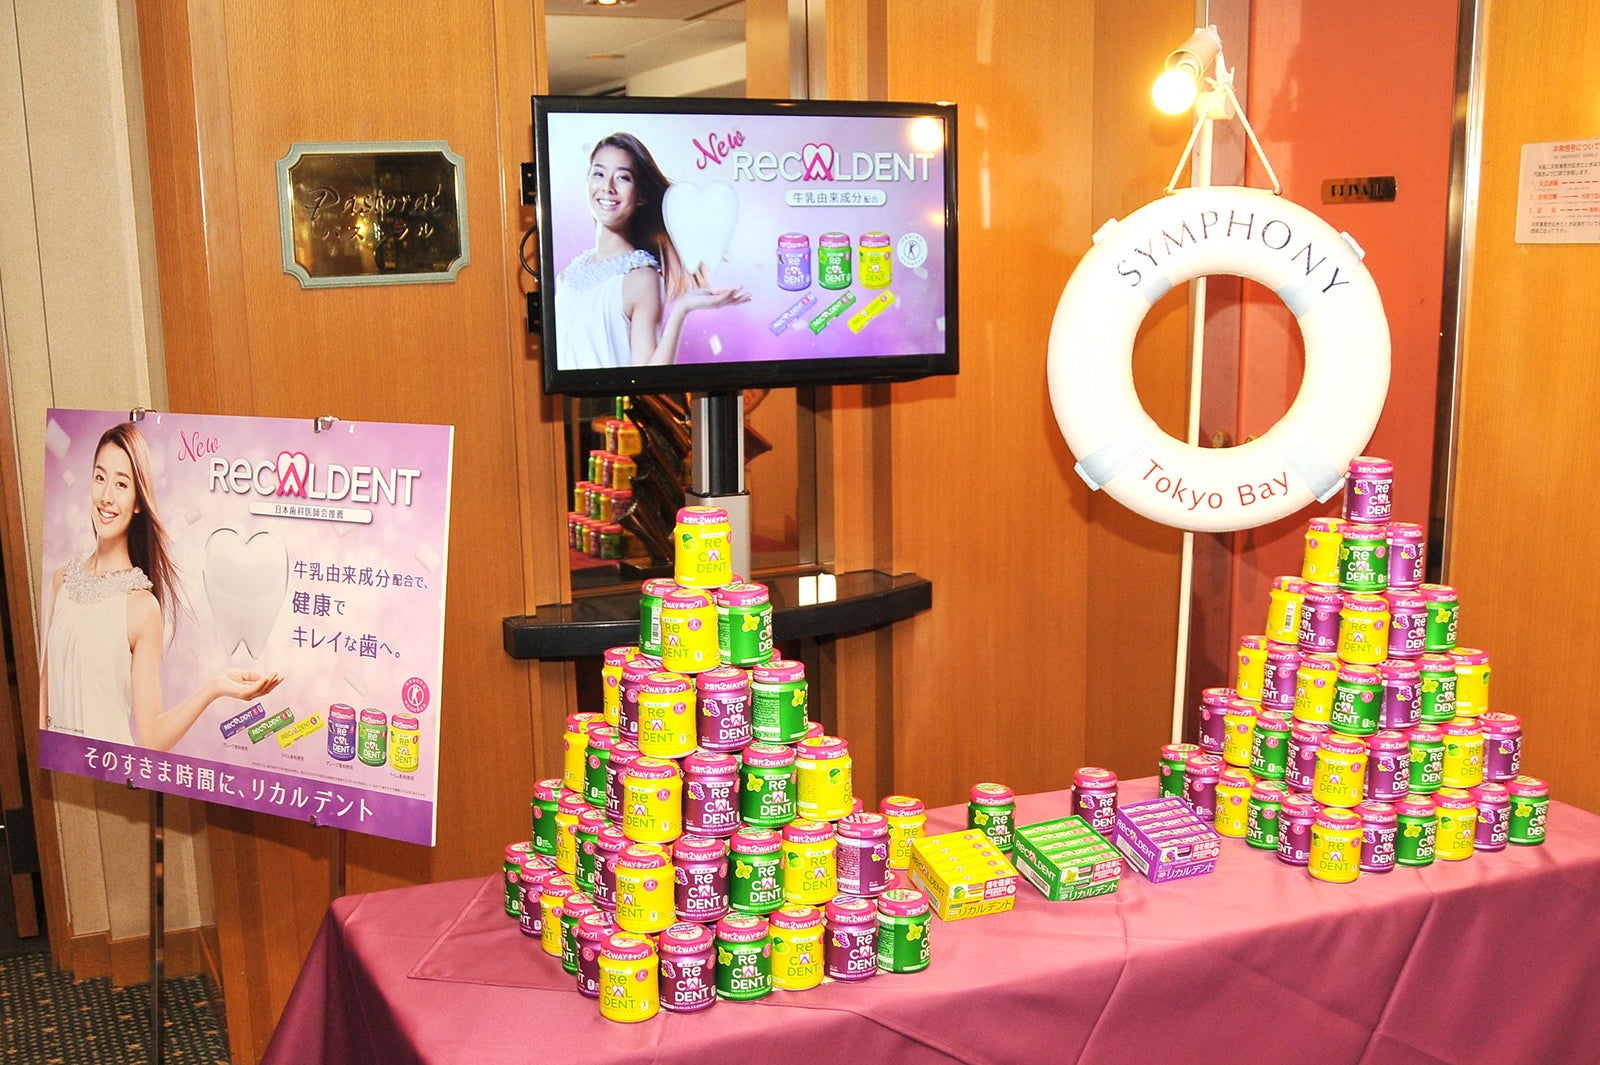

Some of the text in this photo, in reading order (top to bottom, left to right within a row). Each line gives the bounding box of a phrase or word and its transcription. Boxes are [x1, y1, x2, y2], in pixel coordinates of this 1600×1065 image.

[692, 130, 745, 169] New
[304, 184, 441, 221] Pastoral
[1117, 210, 1349, 293] SYMPHONY
[178, 431, 221, 463] New
[1142, 460, 1289, 510] Tokyo Bay
[1375, 484, 1389, 494] Re
[1367, 504, 1391, 515] DENT
[705, 538, 722, 548] Re
[1353, 551, 1369, 560] Re
[697, 562, 727, 573] DENT
[294, 561, 428, 589] 牛乳由来成分配合で、
[1346, 572, 1375, 581] DENT
[291, 590, 346, 618] 健康で
[666, 623, 680, 633] Re
[1351, 623, 1367, 632] Re
[291, 627, 401, 660] キレイな歯へ。
[1345, 641, 1371, 652] DENT
[1339, 692, 1354, 702] Re
[648, 708, 665, 717] Re
[727, 704, 744, 714] Re
[1332, 712, 1359, 724] DENT
[644, 732, 674, 742] DENT
[720, 728, 750, 740] DENT
[1328, 764, 1344, 774] Re
[84, 747, 373, 822] そのすきま時間に、リカルデント
[769, 780, 786, 790] Re
[1320, 785, 1348, 795] DENT
[632, 792, 648, 802] Re
[712, 788, 729, 798] Re
[1099, 798, 1113, 807] Re
[761, 803, 792, 815] DENT
[627, 817, 656, 828] DENT
[703, 811, 734, 824] DENT
[993, 815, 1008, 824] Re
[1328, 841, 1344, 851] Re
[811, 856, 827, 865] Re
[758, 865, 775, 876] Re
[1167, 863, 1214, 879] リカルデント
[1320, 862, 1349, 871] DENT
[694, 874, 713, 884] Re
[620, 881, 635, 892] Re
[803, 880, 833, 891] DENT
[750, 889, 781, 903] DENT
[1069, 883, 1117, 900] リカルデント
[687, 897, 720, 909] DENT
[959, 900, 1012, 917] リカルデント
[857, 934, 872, 945] Re
[796, 942, 814, 952] Re
[738, 955, 757, 965] Re
[848, 959, 876, 971] DENT
[682, 966, 700, 976] Re
[788, 964, 819, 976] DENT
[609, 974, 627, 984] Re
[731, 977, 764, 989] DENT
[675, 989, 708, 1002] DENT
[604, 996, 635, 1009] DENT
